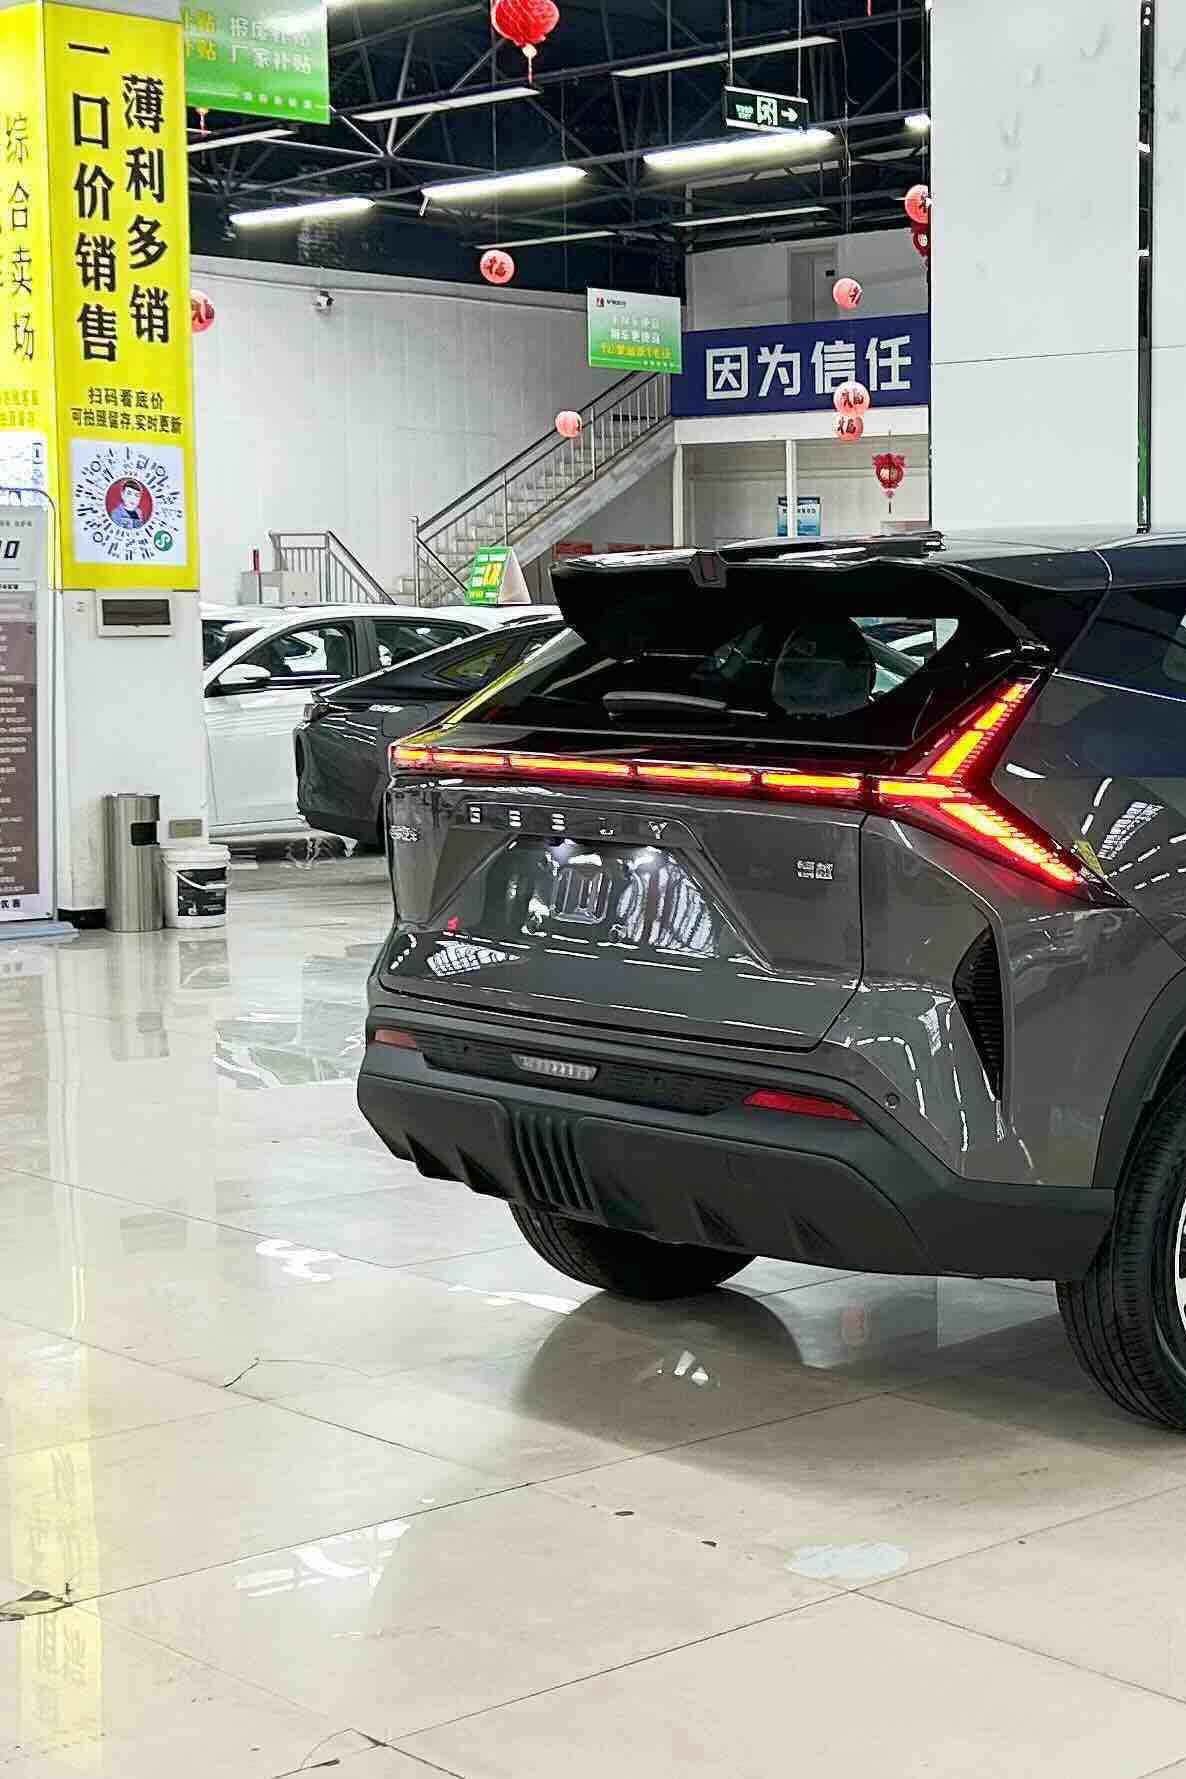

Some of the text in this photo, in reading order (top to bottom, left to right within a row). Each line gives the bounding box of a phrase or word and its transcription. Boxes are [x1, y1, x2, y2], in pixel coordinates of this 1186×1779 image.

[6, 112, 35, 361] 综合卖场
[68, 42, 118, 363] 一口价销售
[122, 73, 169, 344] 薄利多销
[88, 386, 164, 410] 扫码看底价
[706, 335, 912, 401] 因为信任
